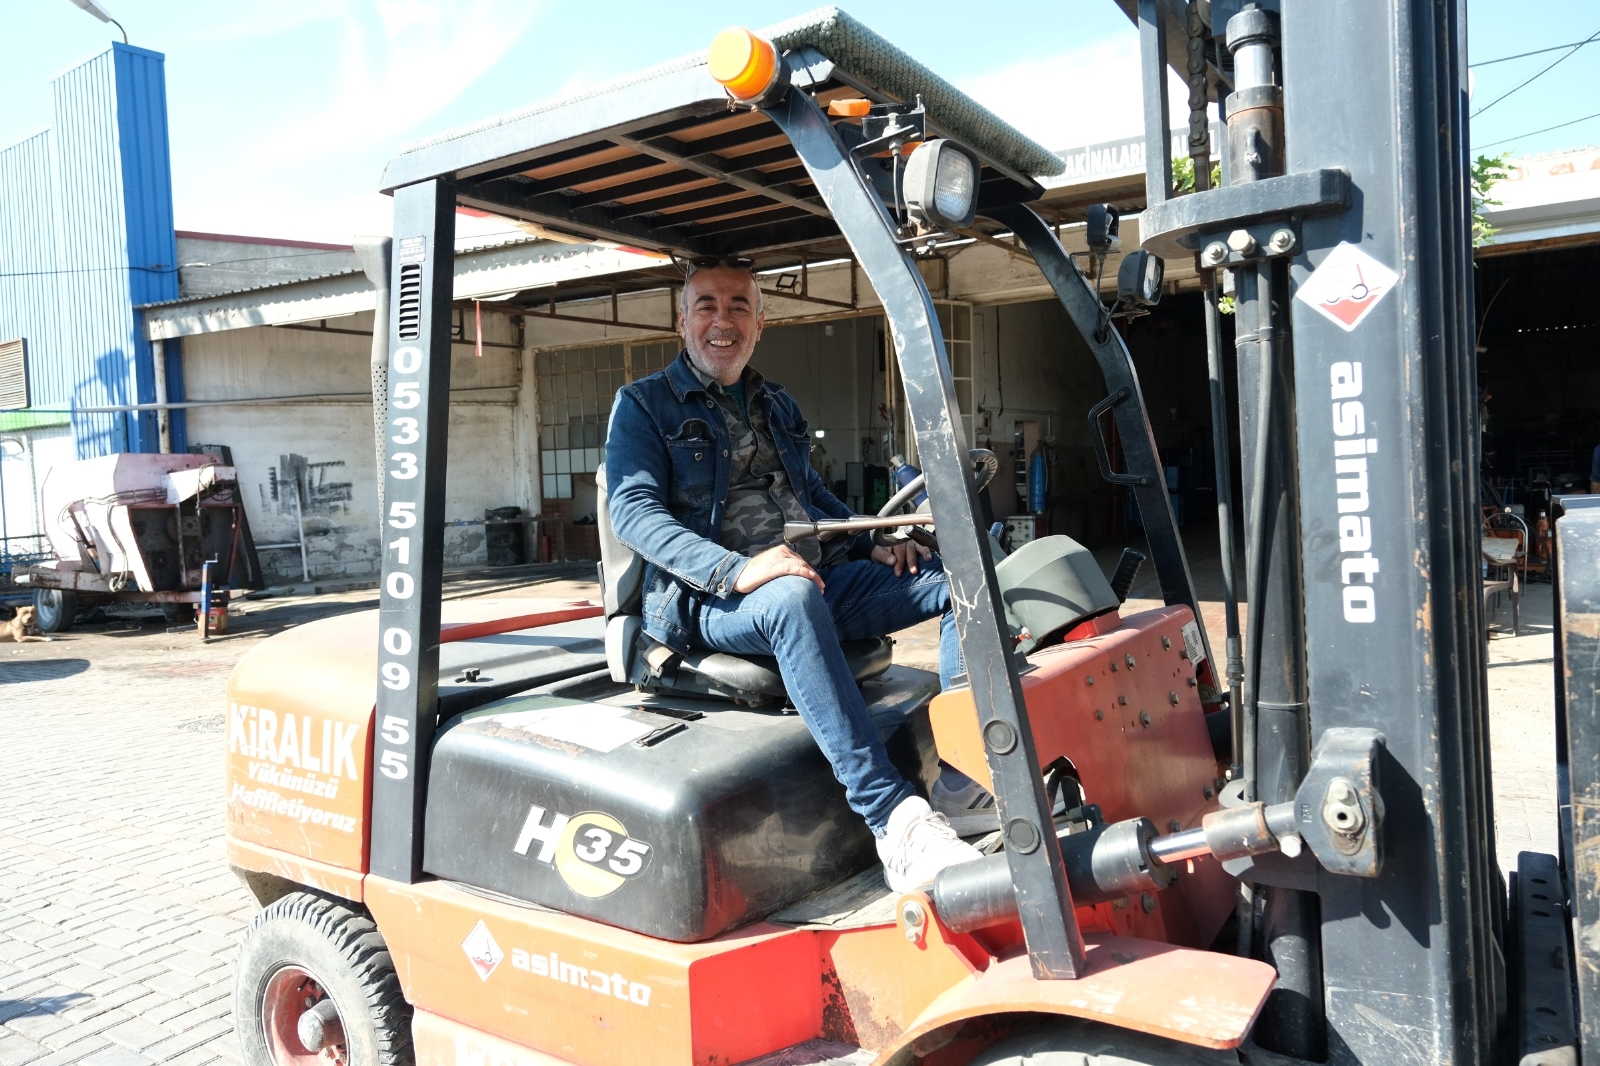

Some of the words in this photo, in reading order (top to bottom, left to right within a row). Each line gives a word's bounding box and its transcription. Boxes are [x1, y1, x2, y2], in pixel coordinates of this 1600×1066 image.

[1059, 141, 1146, 179] AKİNALARI
[389, 346, 422, 480] 0533
[1330, 361, 1380, 623] asimato
[386, 501, 417, 600] 510
[381, 627, 412, 691] 09
[248, 760, 340, 800] Yükünüzü
[379, 714, 410, 780] 55
